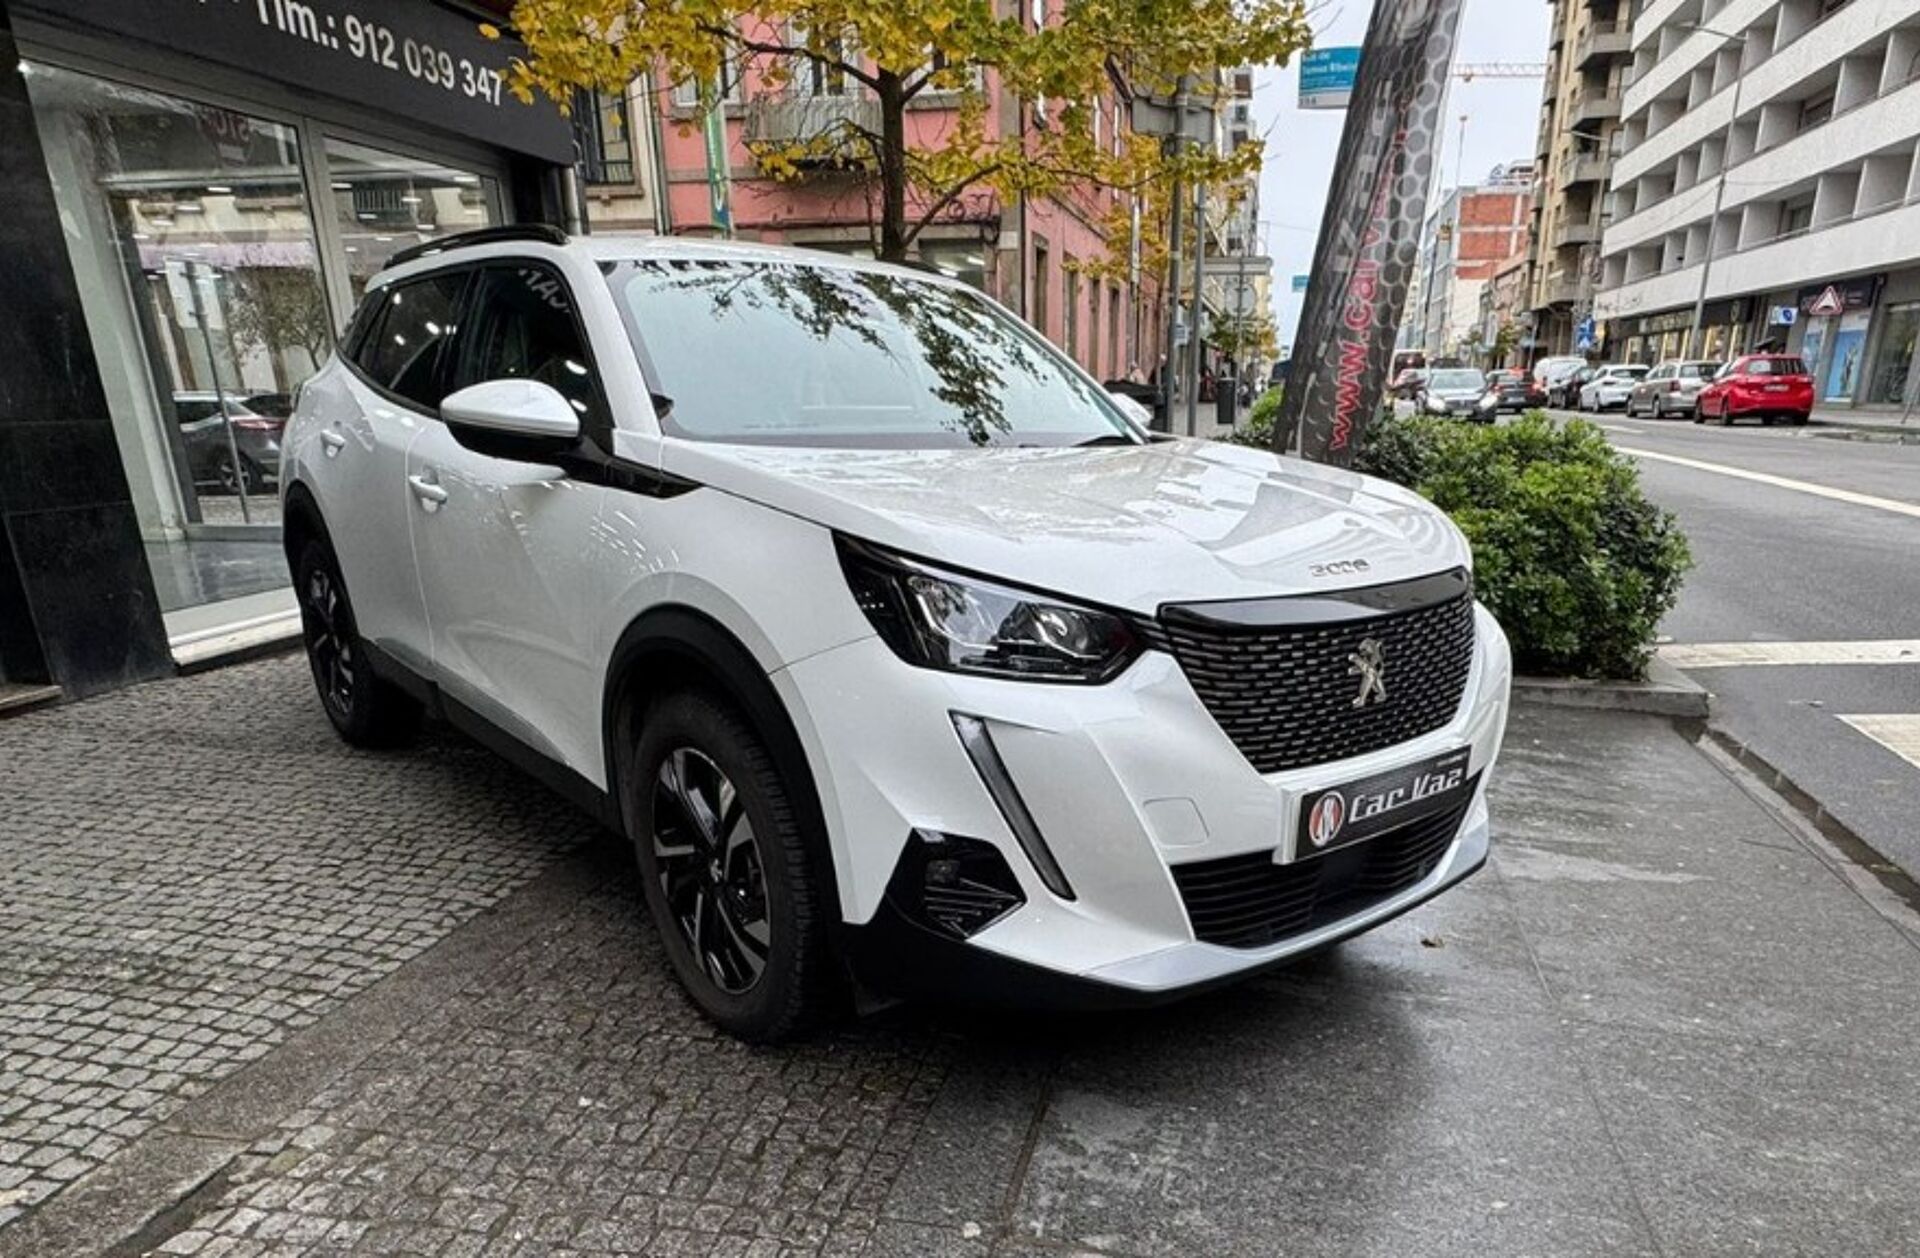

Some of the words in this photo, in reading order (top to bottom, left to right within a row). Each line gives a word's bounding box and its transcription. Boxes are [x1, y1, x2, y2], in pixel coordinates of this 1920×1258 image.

[344, 15, 399, 71] 912
[403, 37, 454, 90] 039
[459, 58, 502, 106] 347
[1347, 787, 1405, 824] Car
